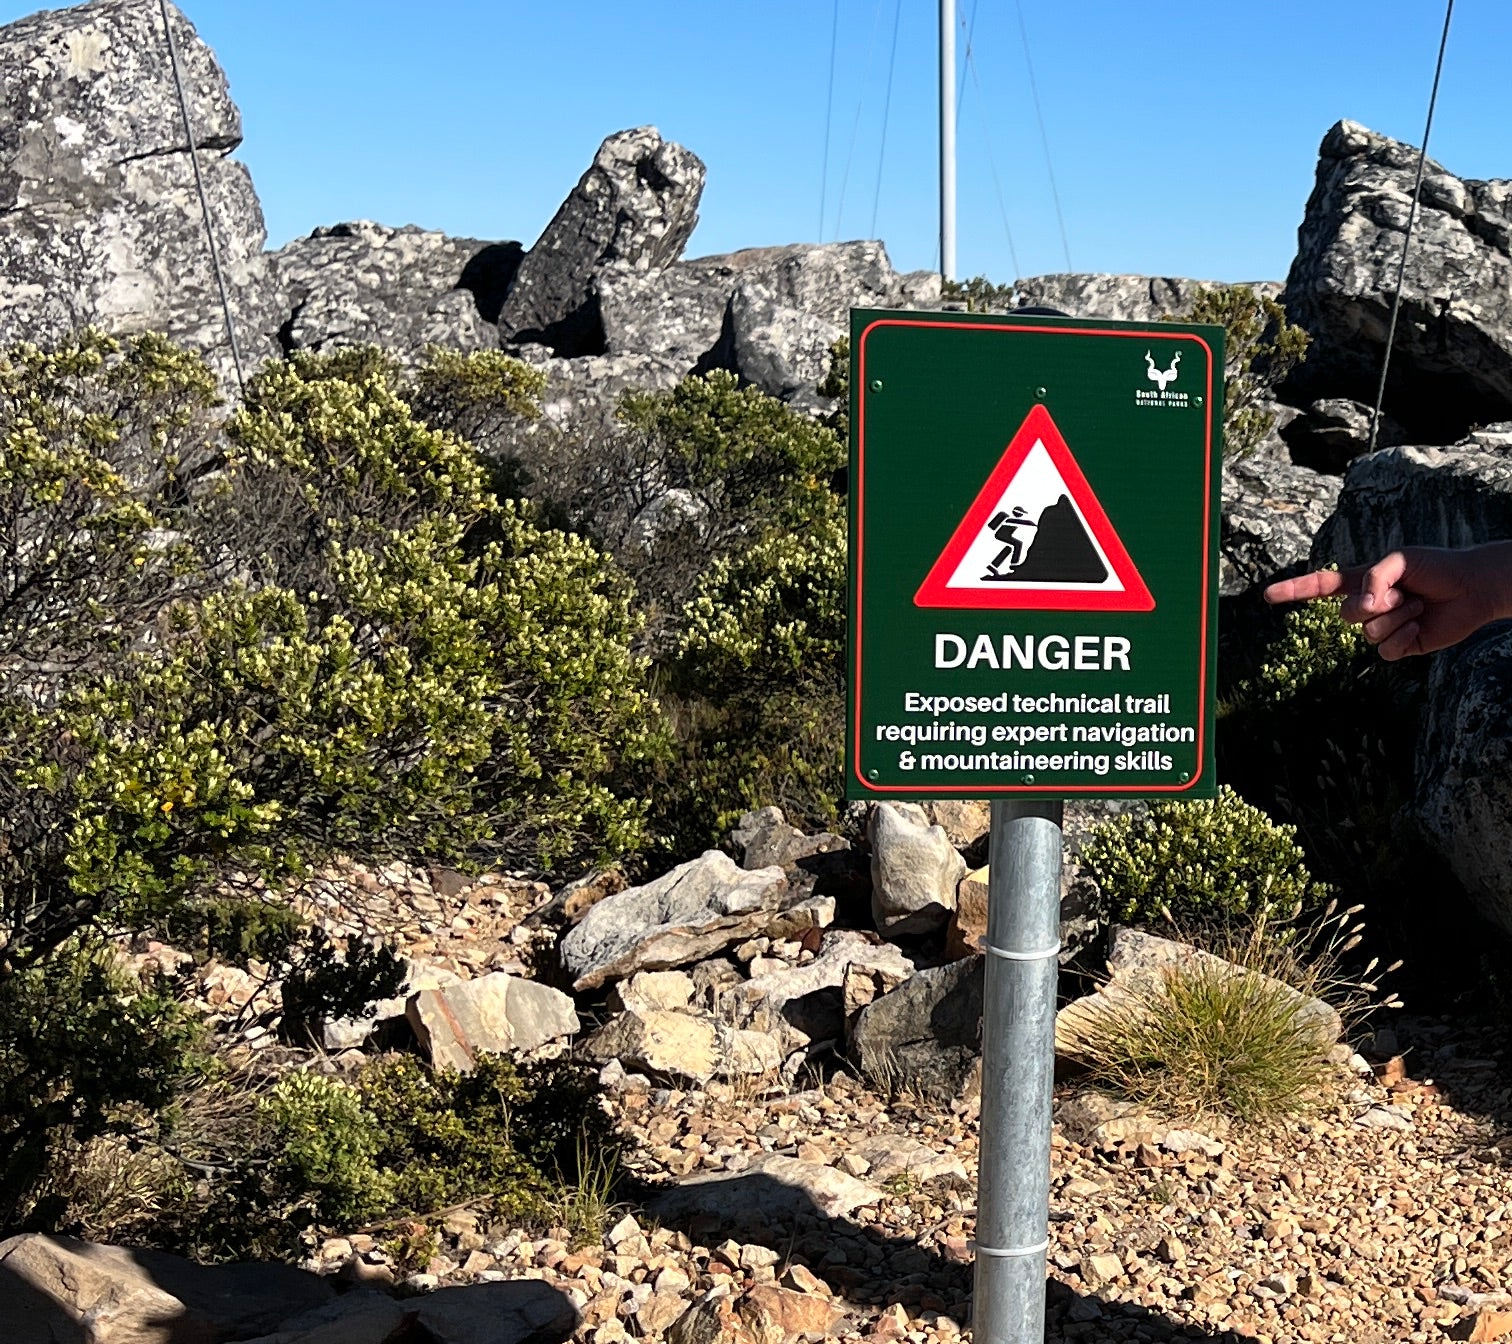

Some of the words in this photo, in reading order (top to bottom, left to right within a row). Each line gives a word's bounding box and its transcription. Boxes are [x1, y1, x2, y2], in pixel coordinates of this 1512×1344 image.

[934, 633, 1131, 671] DANGER
[904, 692, 1008, 716] Exposed
[1012, 692, 1121, 714] technical
[1125, 693, 1171, 714] trail
[876, 721, 987, 746] requiring
[991, 723, 1069, 746] expert
[1072, 722, 1195, 747] navigation
[898, 750, 917, 771] &
[920, 750, 1110, 775] mountaineering
[1114, 750, 1173, 771] skills
